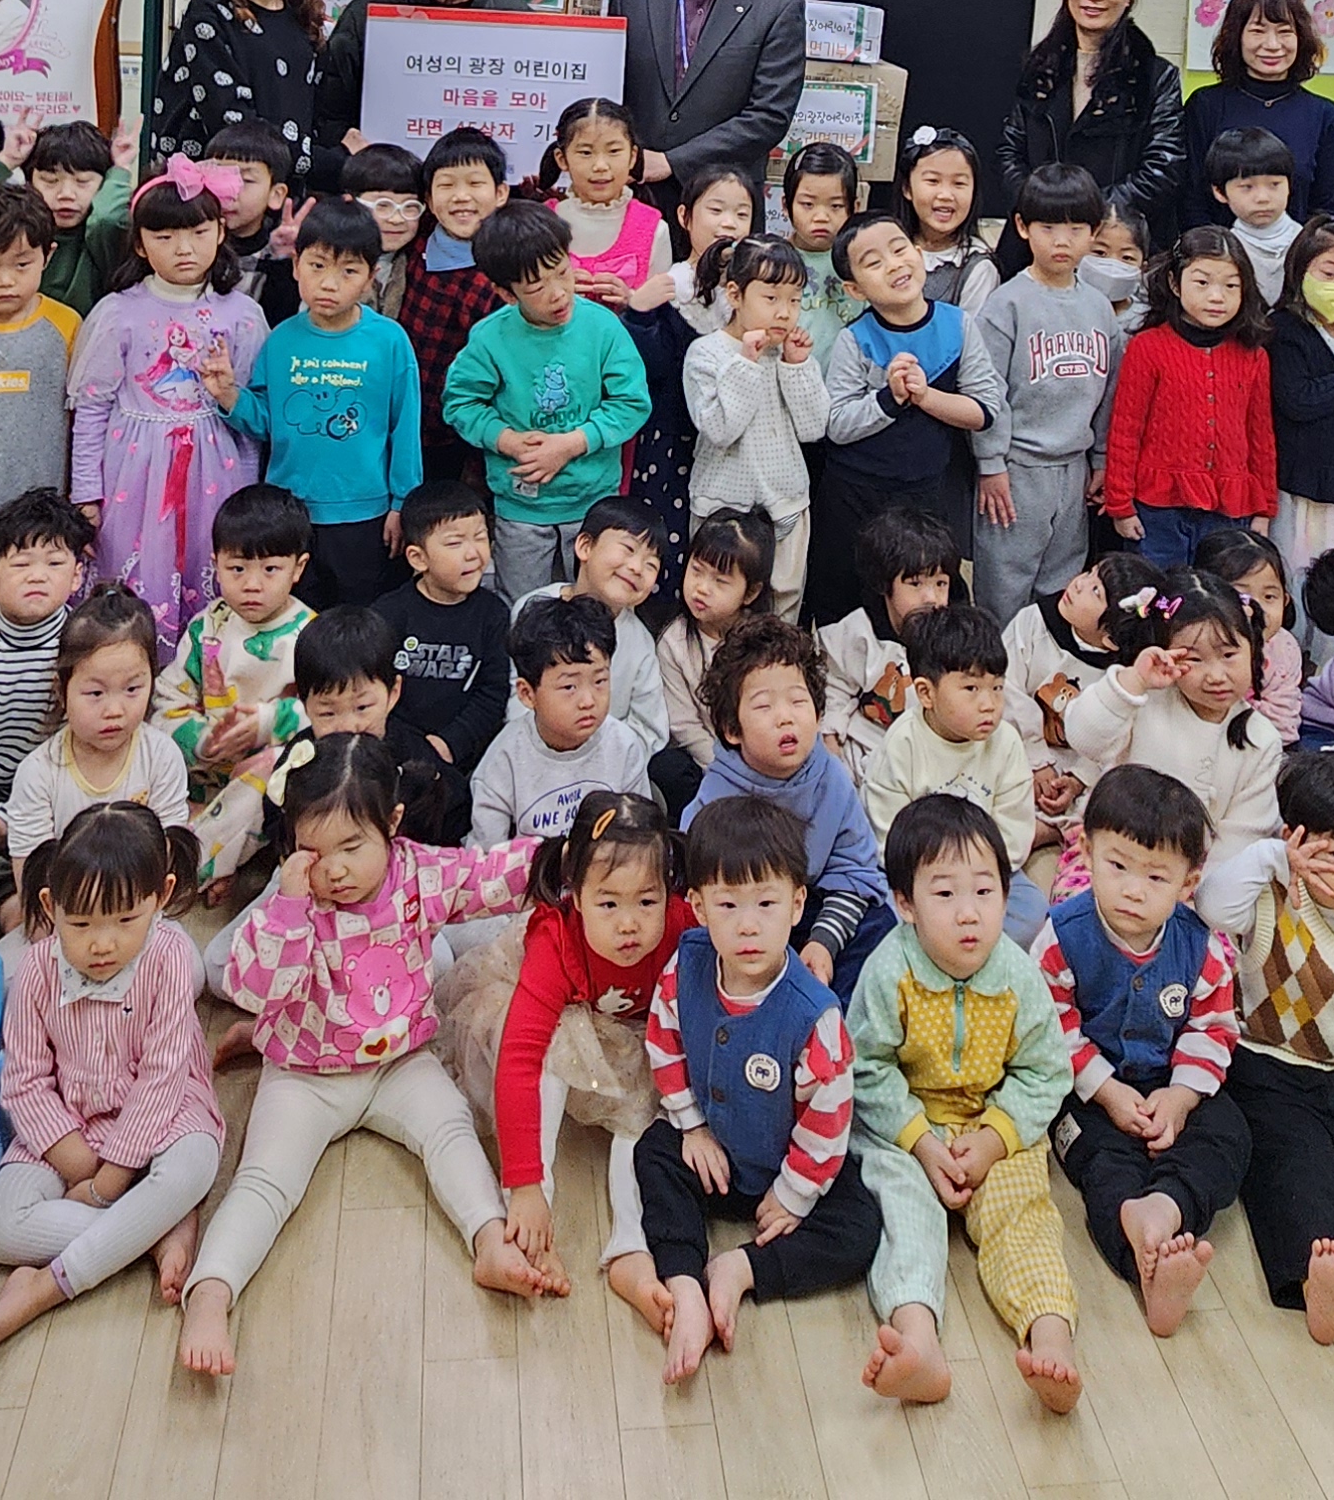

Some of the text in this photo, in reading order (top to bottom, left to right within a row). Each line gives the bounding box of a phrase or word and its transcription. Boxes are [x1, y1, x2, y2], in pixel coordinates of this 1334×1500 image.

[405, 54, 588, 81] 여성의 광장 어린이집
[443, 88, 547, 110] 마음을 모아
[406, 117, 443, 137] 라면
[534, 123, 560, 141] 기
[1028, 327, 1109, 385] HARVARD
[409, 643, 473, 661] STAR
[407, 660, 472, 679] WARS
[557, 788, 582, 806] AVOIR
[533, 811, 560, 829] UNE
